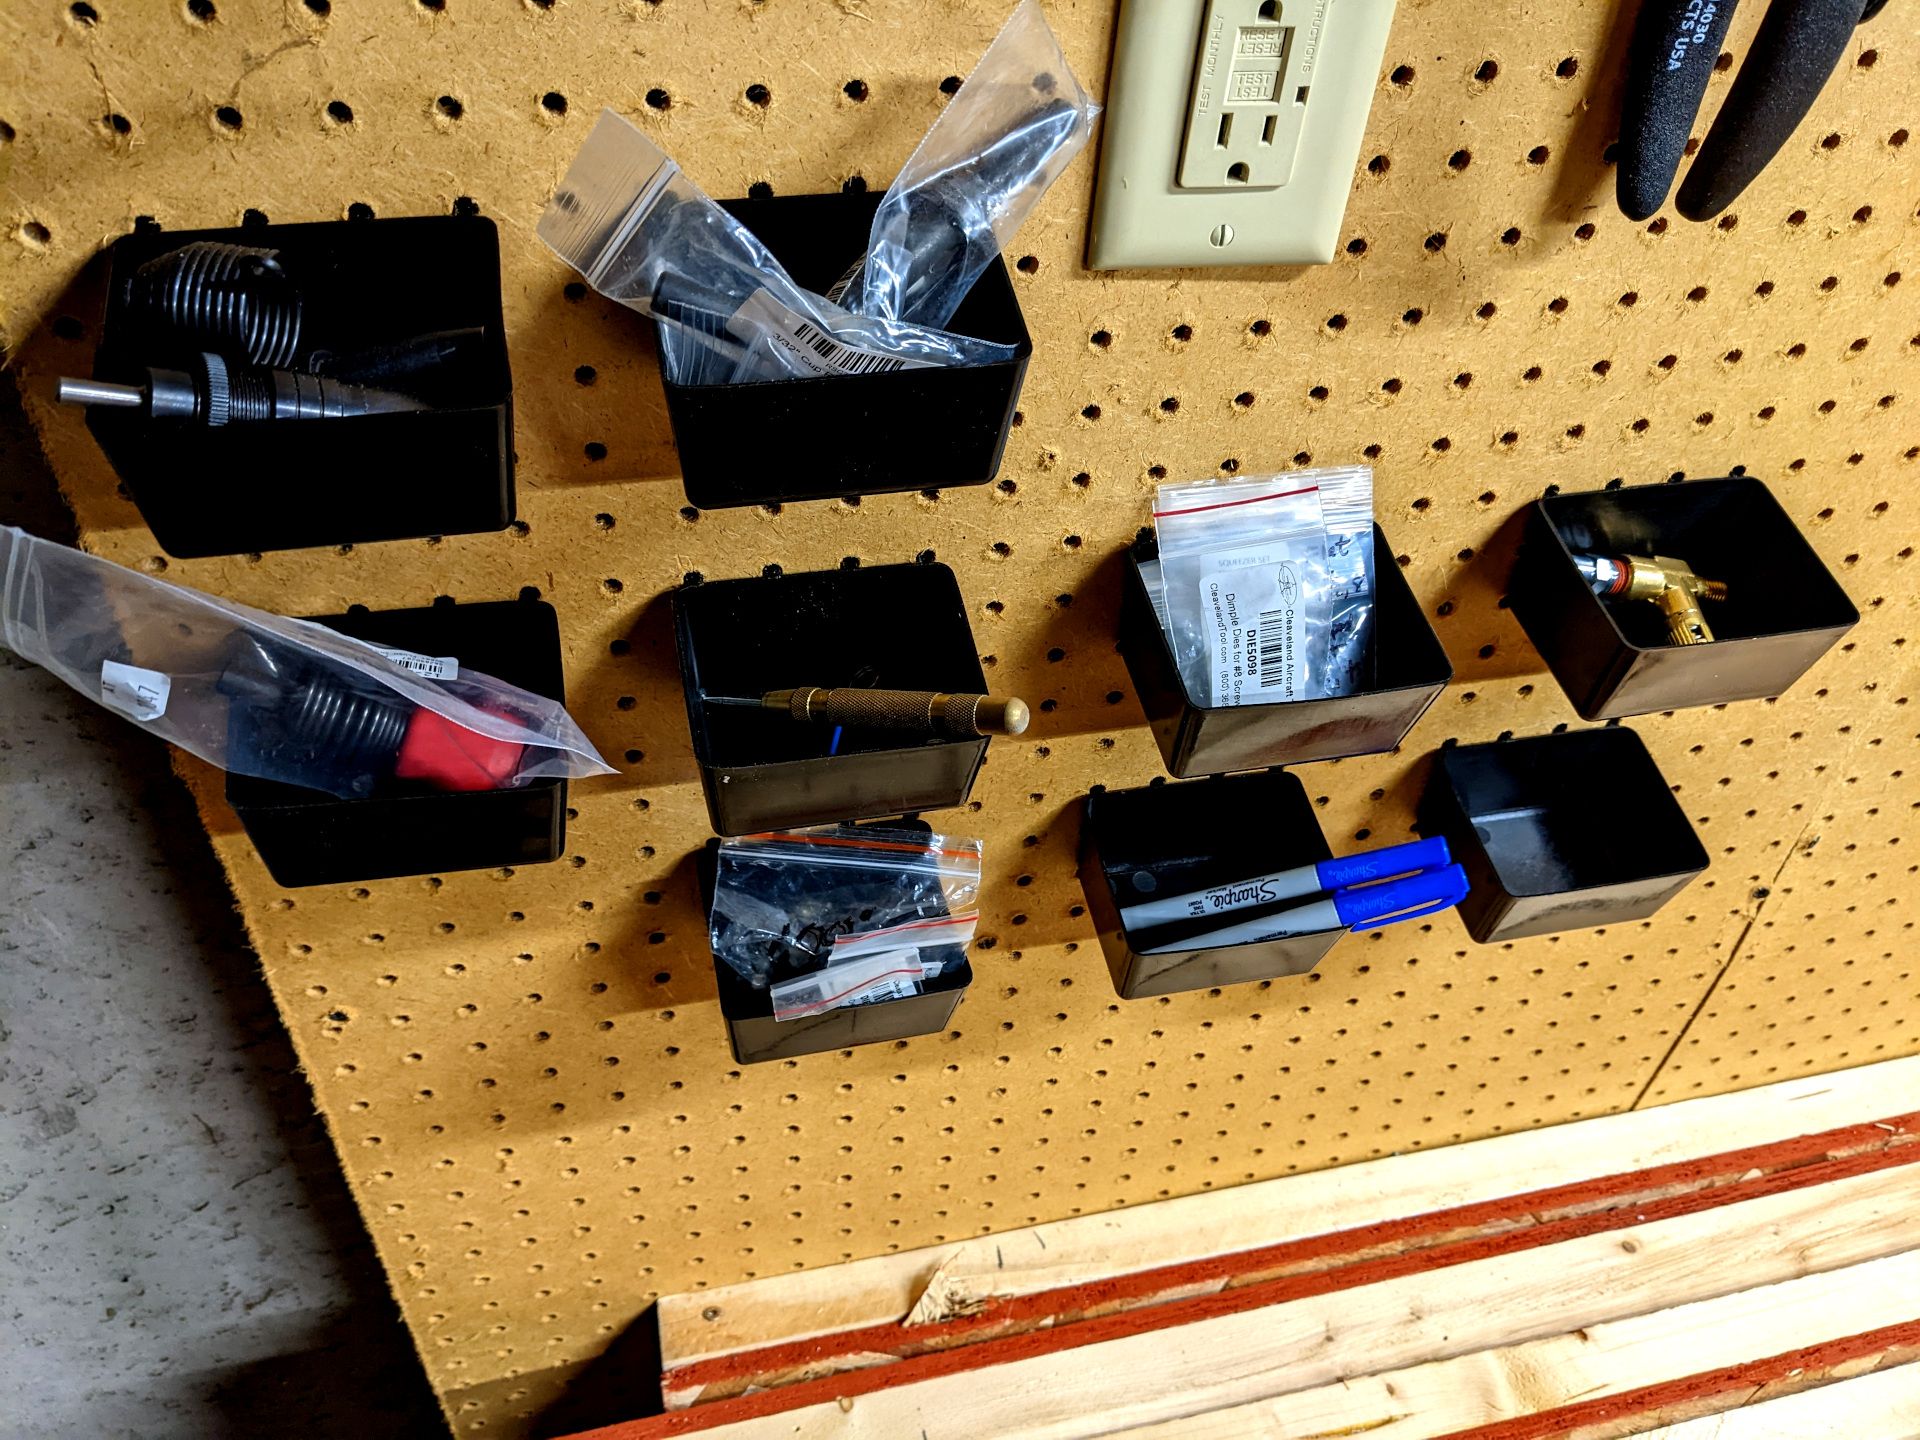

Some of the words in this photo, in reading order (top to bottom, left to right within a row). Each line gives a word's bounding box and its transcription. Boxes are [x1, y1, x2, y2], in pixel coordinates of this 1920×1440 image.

[1239, 28, 1285, 41] RESET
[1692, 0, 1719, 44] 4030
[1204, 14, 1225, 78] MONTHLY
[1238, 43, 1282, 54] RESET
[1302, 0, 1325, 73] TRUCTIONS
[1666, 37, 1690, 71] USA
[1236, 73, 1273, 84] TEST
[1197, 85, 1212, 117] TEST
[1235, 87, 1269, 98] TEST
[772, 332, 801, 354] 3/32"
[801, 355, 822, 373] Cup
[1225, 593, 1240, 627] Dimple
[1210, 582, 1228, 664] CleavelandTool.com
[1220, 670, 1230, 692] (800)
[1232, 628, 1242, 650] Dies
[1285, 609, 1295, 662] Cleaveland
[1233, 651, 1243, 663] for
[1246, 629, 1258, 676] DIE5098
[1233, 665, 1243, 678] #8
[1285, 663, 1295, 698] Aircraft
[1232, 877, 1265, 889] Permanent
[1333, 861, 1378, 882] Sharpie
[1187, 899, 1203, 907] POINT
[1206, 886, 1227, 895] Marker
[1209, 879, 1280, 910] Sharpie
[1352, 892, 1397, 915] Sharpie
